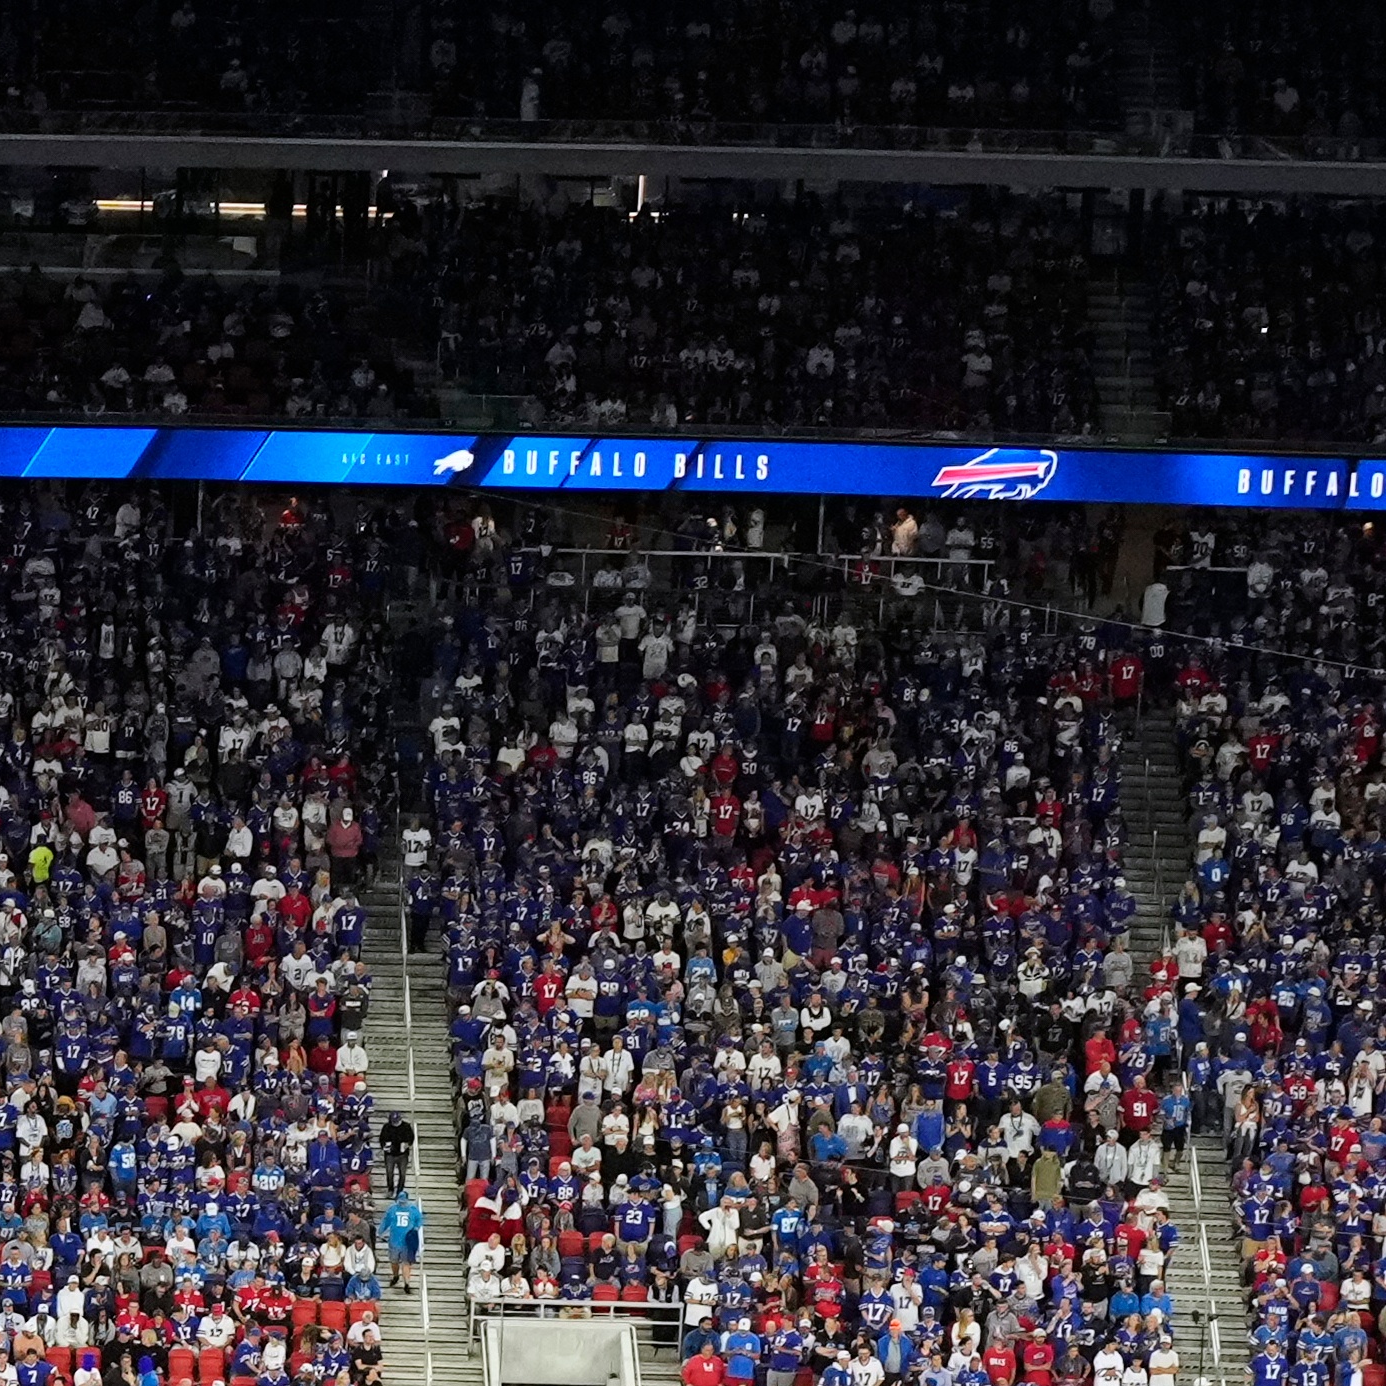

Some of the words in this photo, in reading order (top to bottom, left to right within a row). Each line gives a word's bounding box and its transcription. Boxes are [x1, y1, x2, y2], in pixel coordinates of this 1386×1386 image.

[376, 454, 411, 466] EAST
[502, 449, 647, 477] BUFFALO
[674, 453, 770, 481] BILLS
[1237, 468, 1384, 498] BUFFALO
[366, 561, 377, 572] 17
[511, 563, 522, 574] 17
[1123, 666, 1134, 679] 17
[147, 798, 159, 810] 17
[720, 805, 732, 818] 17
[544, 984, 556, 998] 17
[67, 1045, 80, 1058] 17
[929, 1196, 941, 1210] 17
